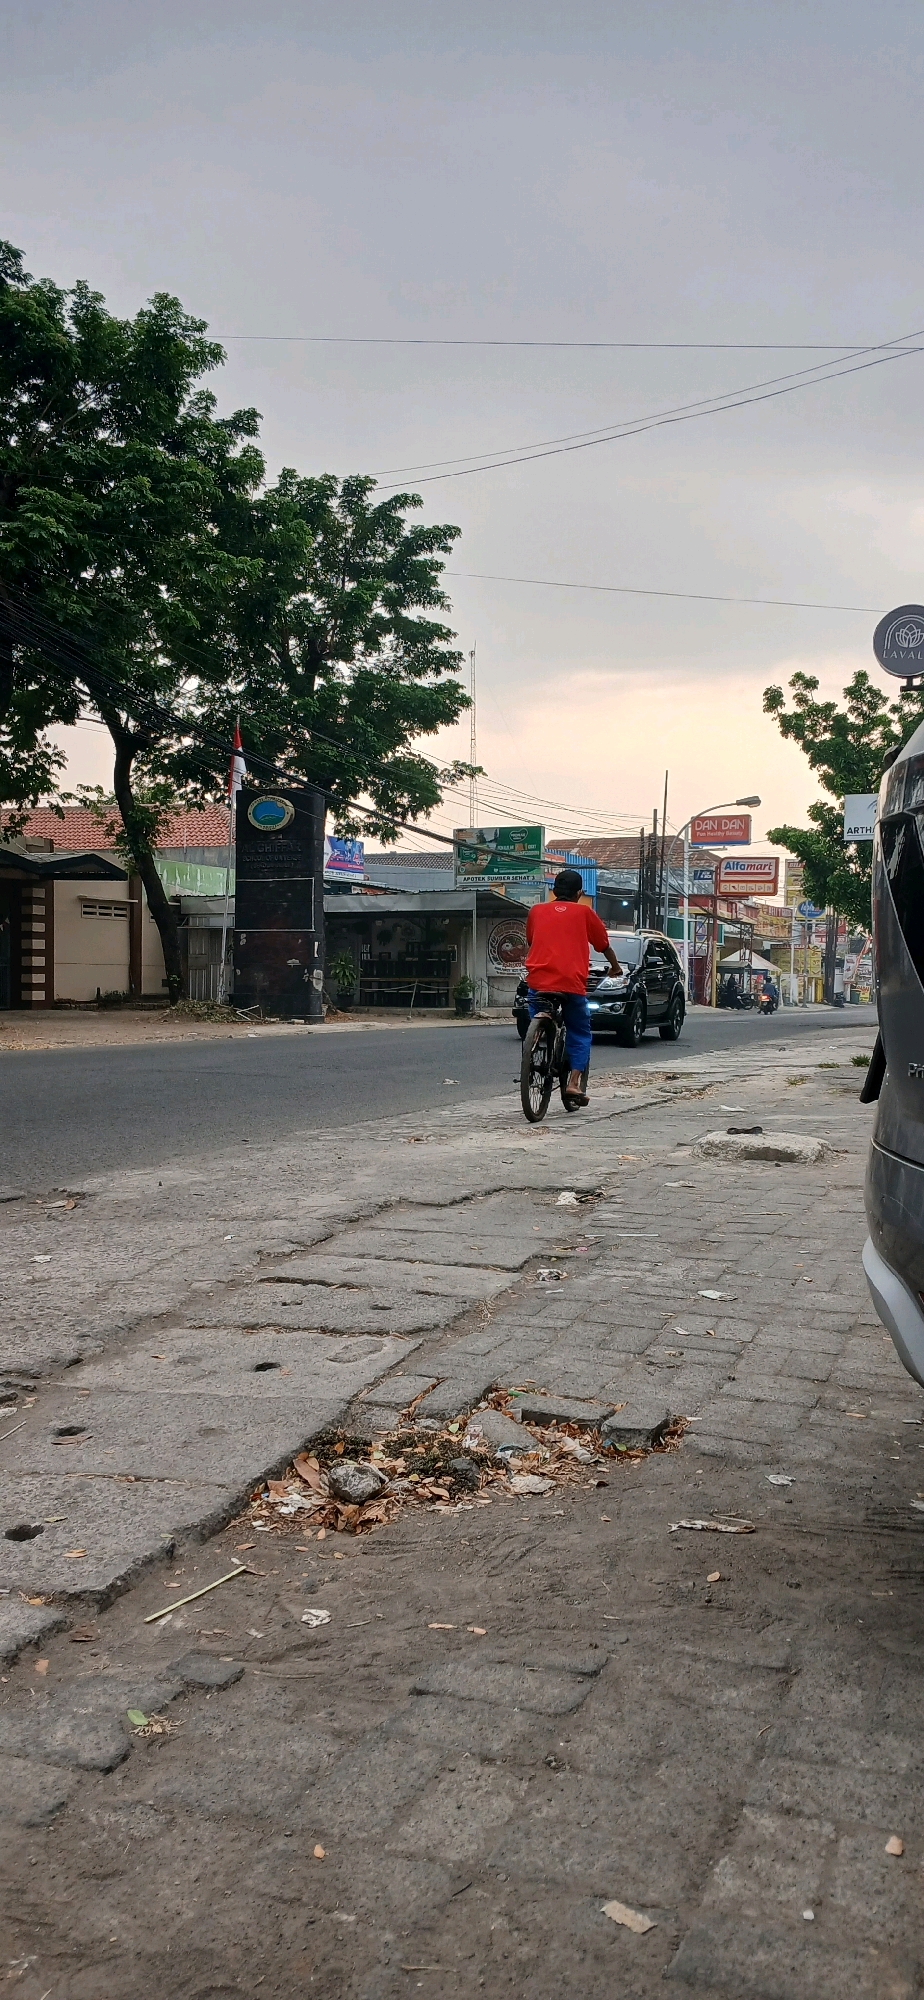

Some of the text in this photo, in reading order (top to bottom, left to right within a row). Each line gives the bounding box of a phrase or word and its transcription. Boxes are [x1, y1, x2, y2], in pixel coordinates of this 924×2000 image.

[695, 819, 745, 831] DAN DAN
[847, 826, 874, 834] ARTH
[724, 861, 773, 870] Alfamart
